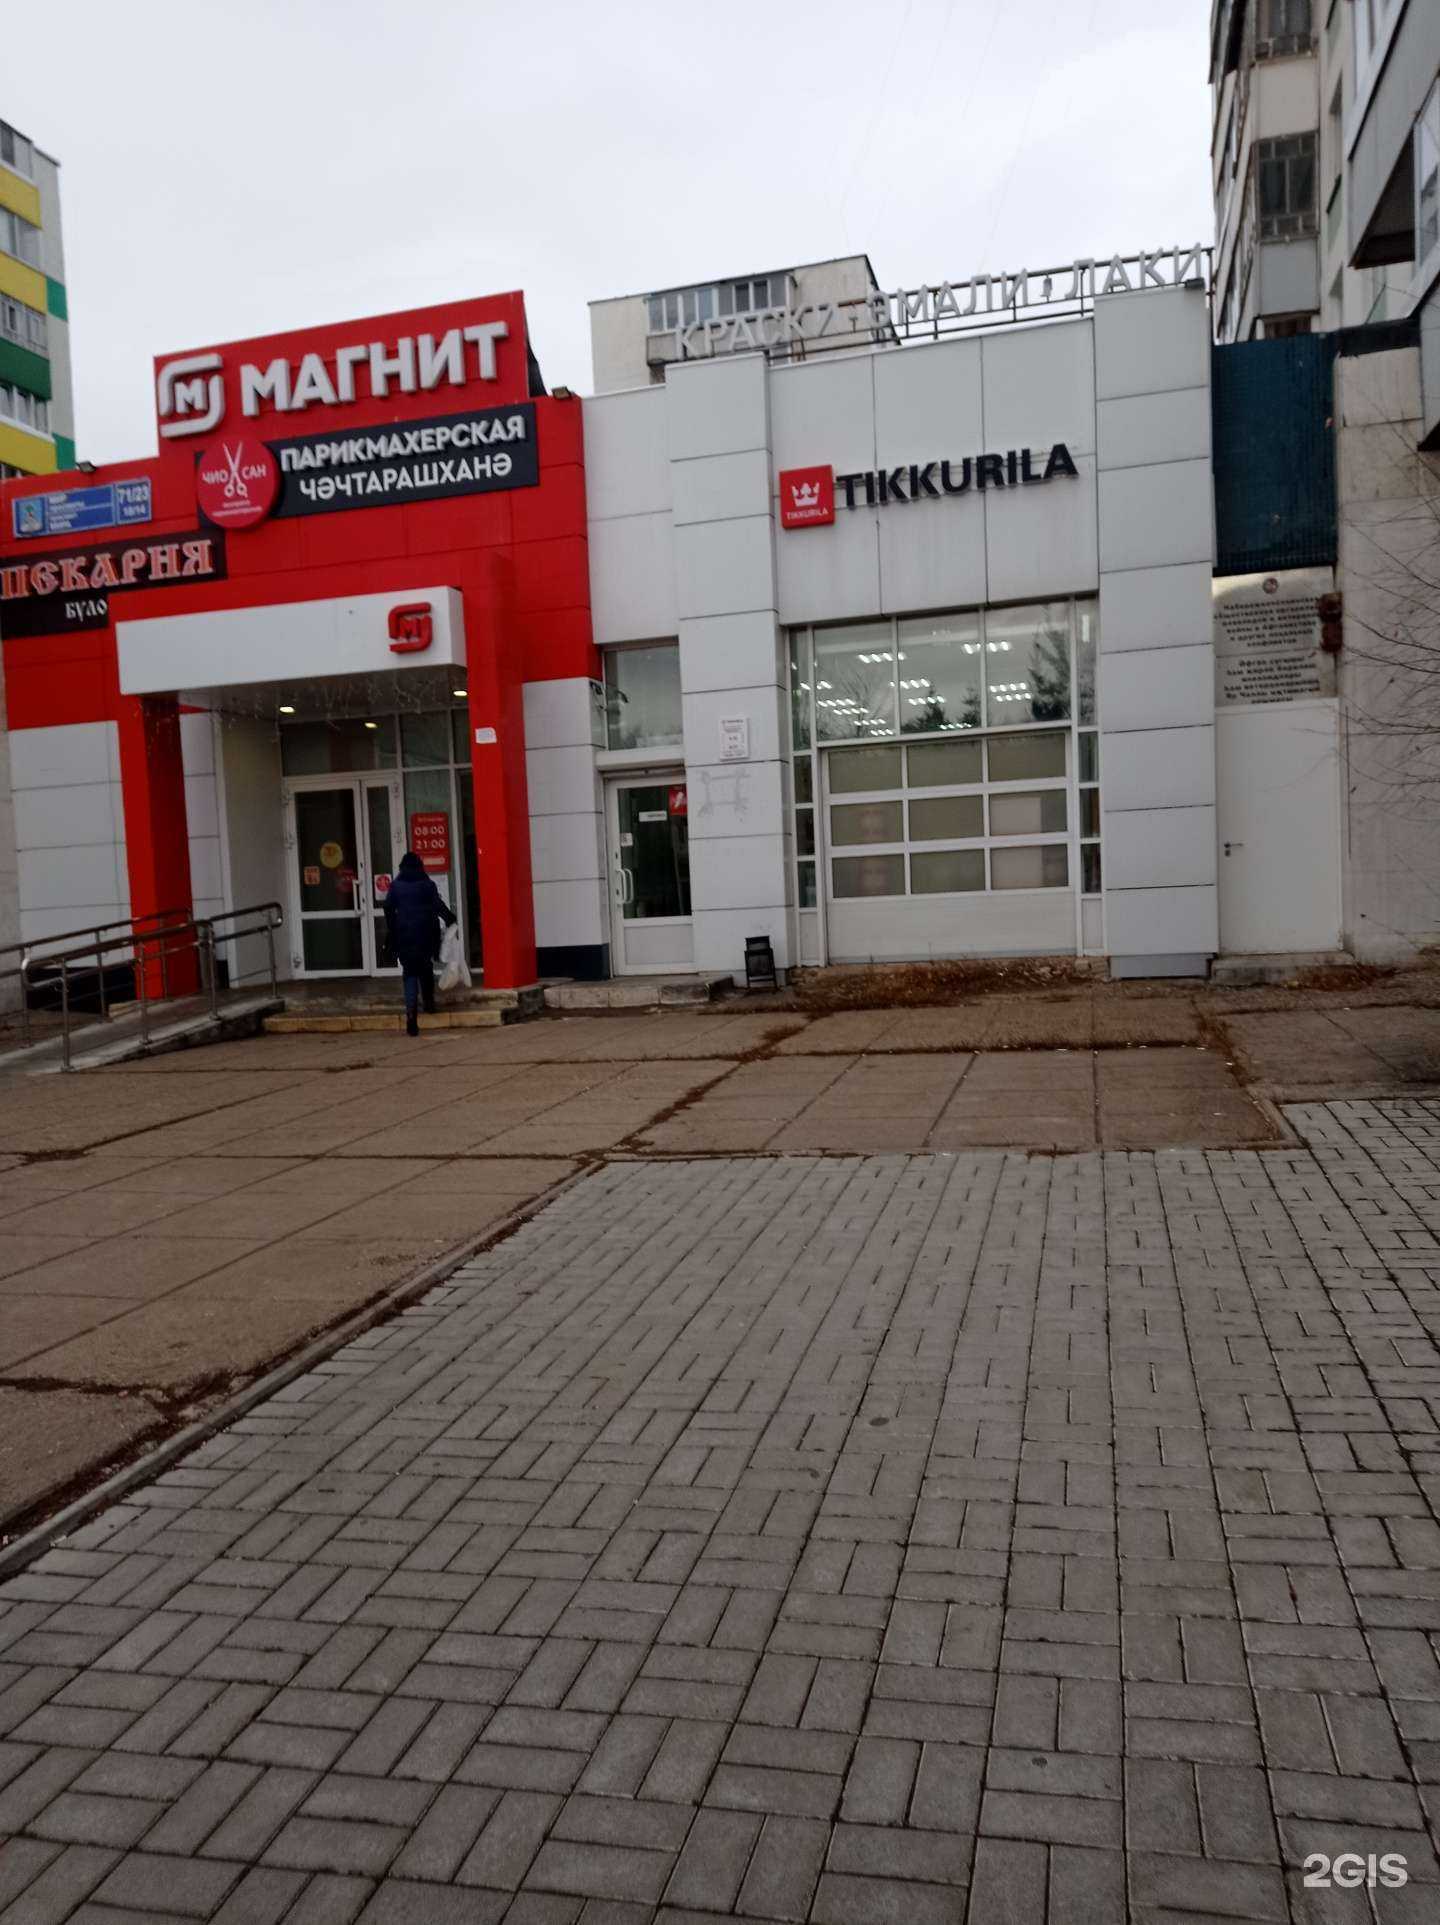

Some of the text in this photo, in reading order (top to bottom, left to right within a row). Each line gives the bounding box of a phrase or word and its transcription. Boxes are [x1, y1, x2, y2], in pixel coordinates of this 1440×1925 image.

[867, 267, 1029, 330] ЭМАЛИ
[1064, 242, 1202, 301] ЛАКИ
[240, 320, 508, 417] МАГНИТ
[280, 414, 526, 472] ПАРИКМАХЕРСКАЯ
[202, 464, 267, 484] ЧИО САН
[300, 452, 513, 501] ЧӘЧТАРАШХАНӘ
[835, 443, 1079, 511] TIKKURILA
[0, 539, 215, 600] ПЕКАРНЯ
